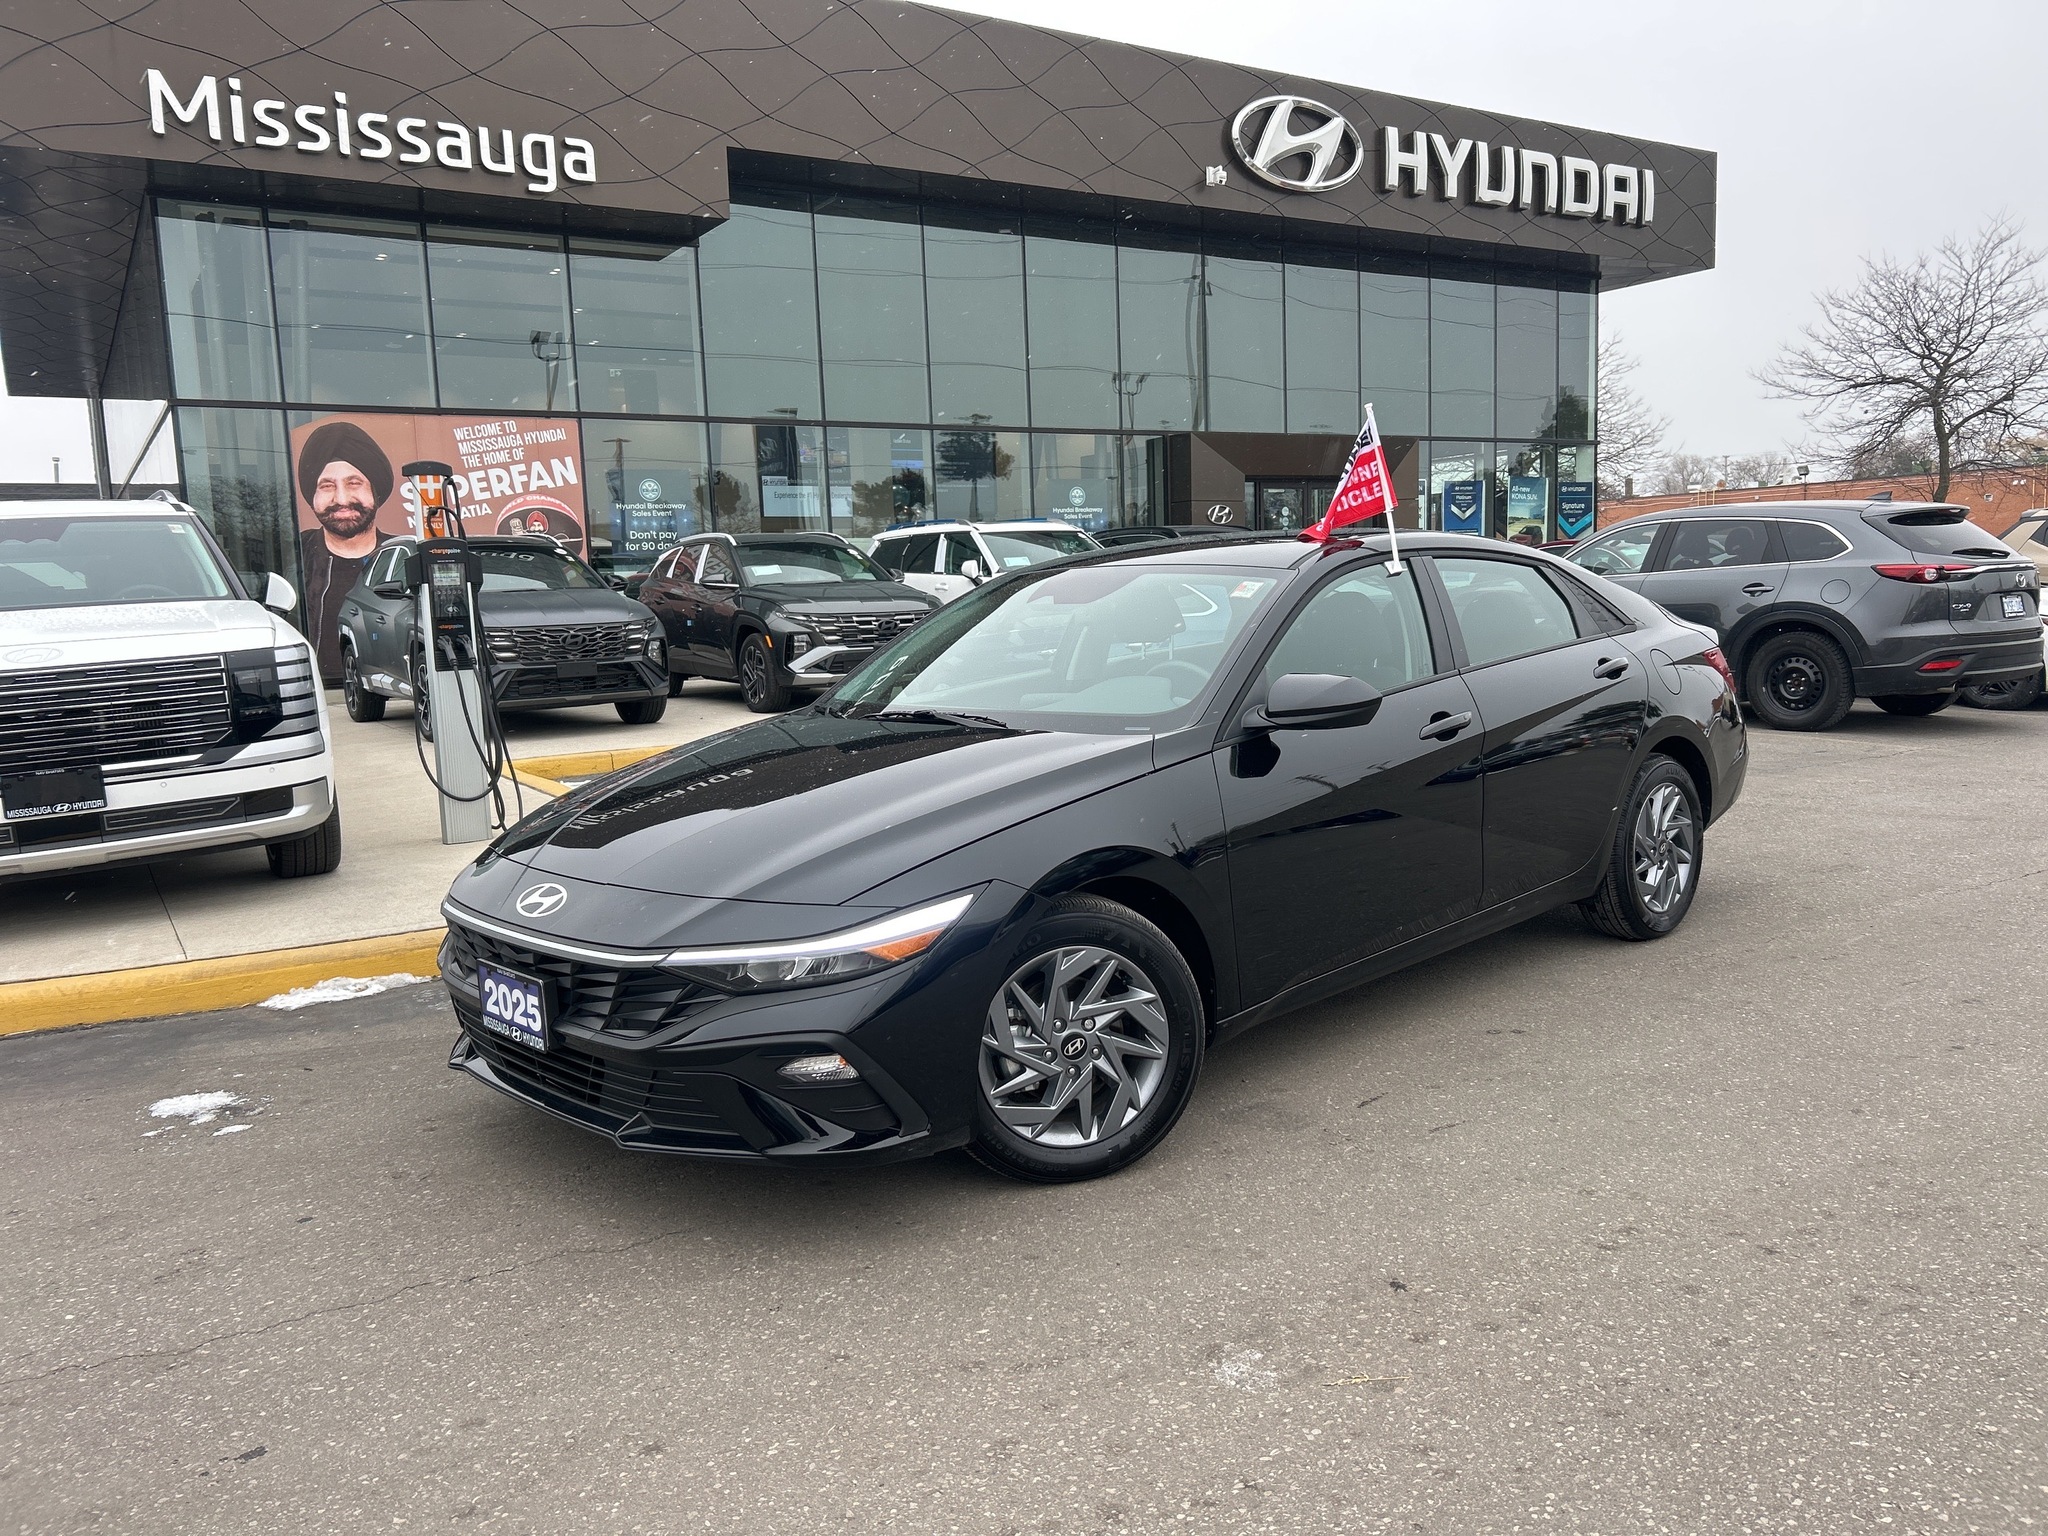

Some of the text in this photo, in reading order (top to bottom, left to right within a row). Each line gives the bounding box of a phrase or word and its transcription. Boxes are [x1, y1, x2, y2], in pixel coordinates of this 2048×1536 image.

[147, 68, 597, 194] Mississauga
[1382, 125, 1656, 227] HYUNDAI
[453, 420, 517, 441] WELCOME TO
[458, 428, 567, 455] MISSISSAUGA HYUNDAI
[461, 447, 525, 469] THE HOME OF
[616, 503, 687, 511] Hyundai Breakaway
[1561, 502, 1585, 510] Signature
[625, 541, 640, 551] for
[641, 541, 656, 551] 90
[629, 530, 678, 541] Don't pay
[6, 799, 105, 818] MISSISSAUGA HYUNDAI
[484, 978, 542, 1032] 2025
[482, 1014, 545, 1052] MISSISSAUGA HYUNDAI
